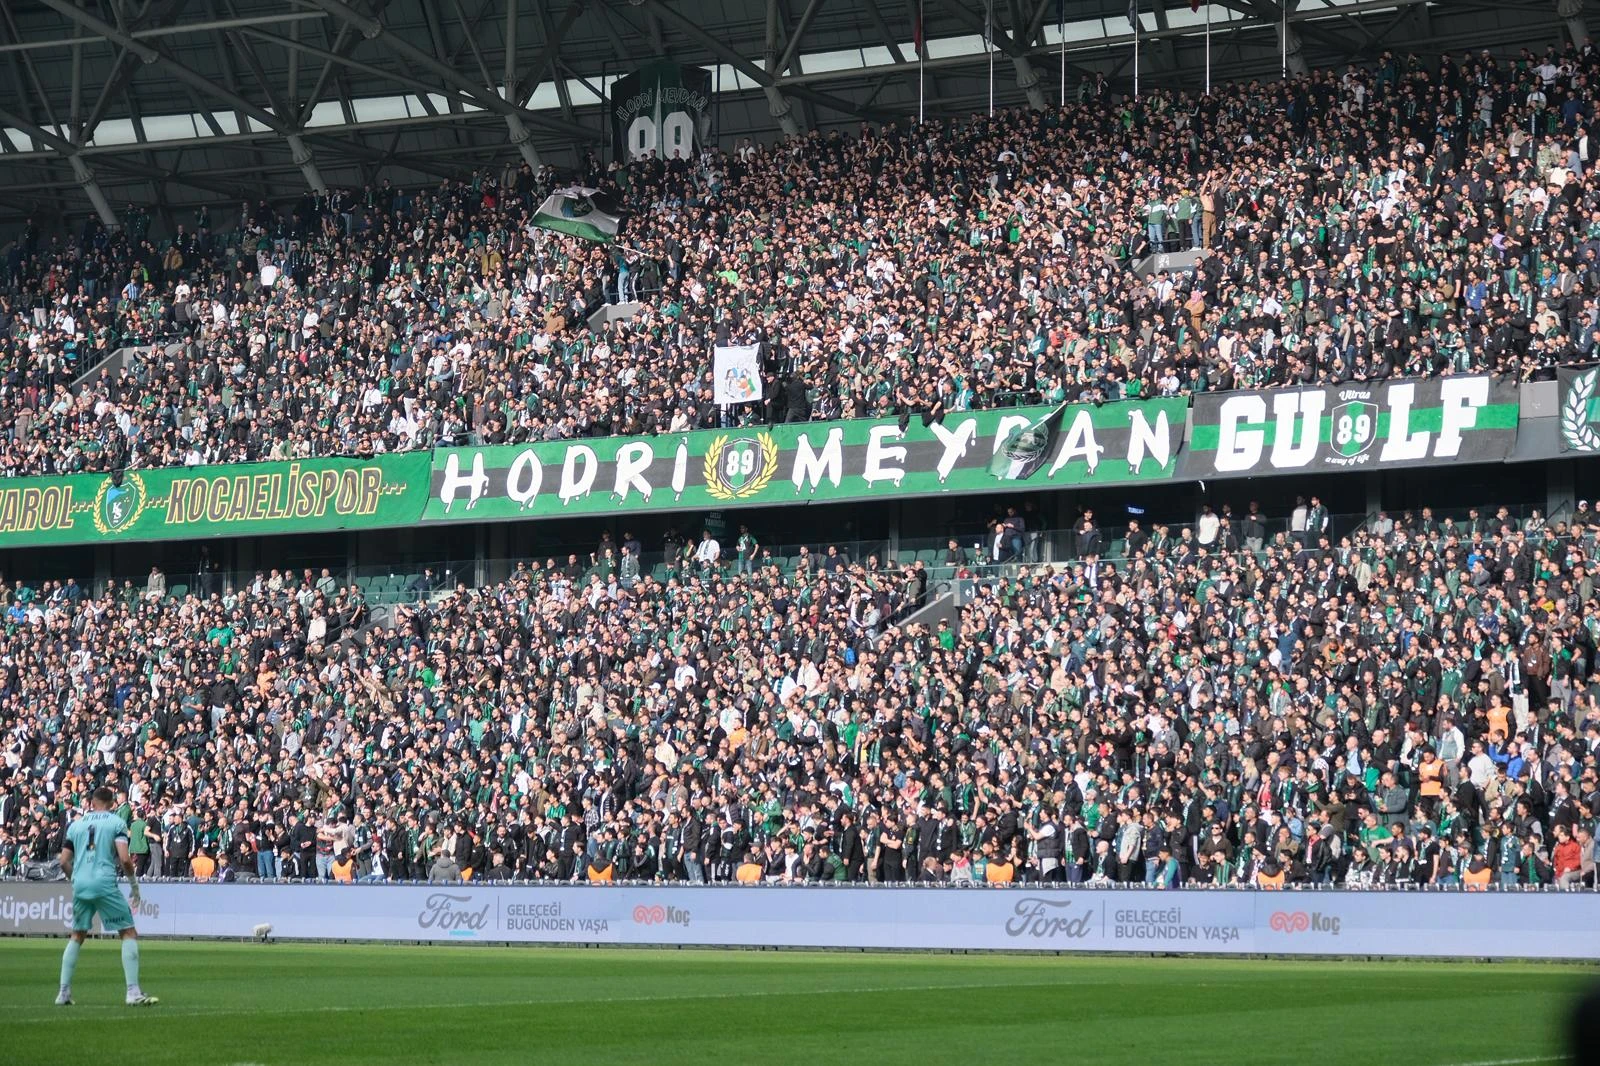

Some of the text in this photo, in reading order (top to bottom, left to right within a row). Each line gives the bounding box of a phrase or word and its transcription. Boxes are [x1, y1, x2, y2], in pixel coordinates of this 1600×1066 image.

[1339, 390, 1371, 401] Ultras
[1337, 414, 1371, 445] 89
[726, 449, 754, 476] 89
[0, 463, 382, 533] AROL KOCAELİSPOR
[86, 824, 96, 851] 1
[418, 893, 490, 930] Ford
[507, 901, 561, 918] GELECEĞİ
[666, 905, 691, 927] Koç
[1005, 897, 1094, 938] Ford
[1115, 906, 1181, 925] GELECEĞİ
[507, 916, 609, 934] BUGÜNDEN YAŞA
[1115, 922, 1240, 943] BUGÜNDEN YAŞA
[1311, 912, 1341, 935] Koç
